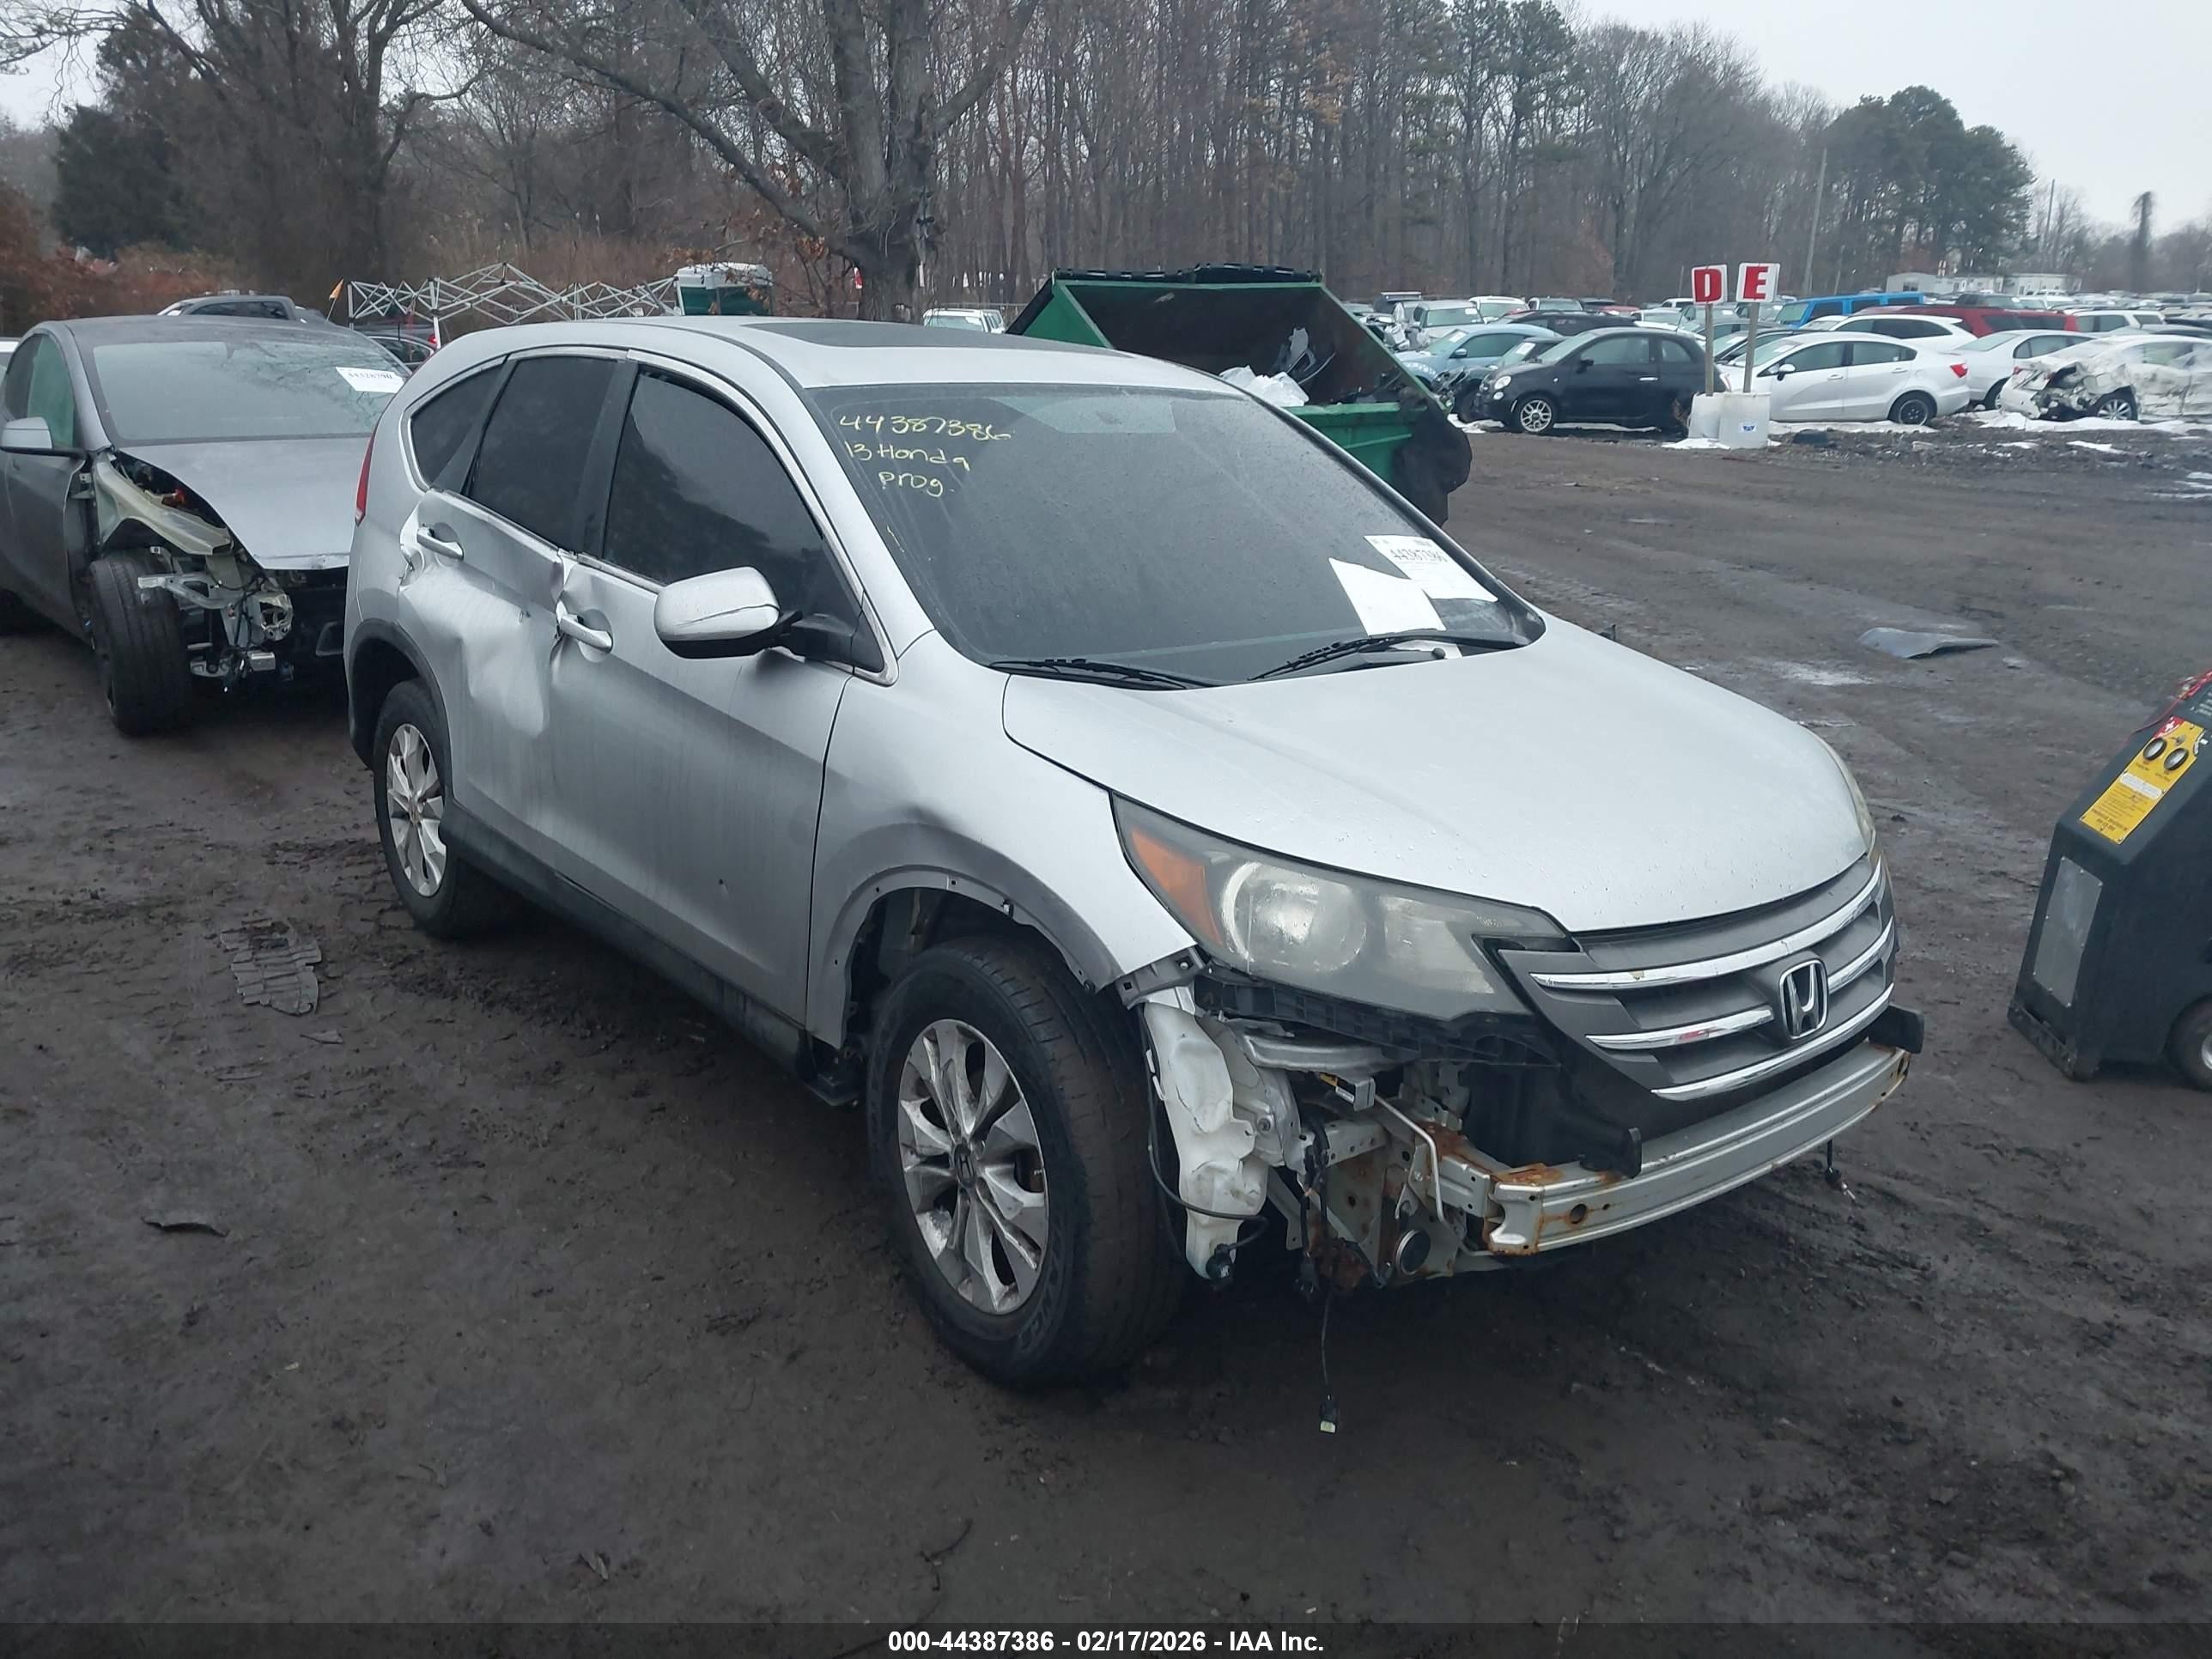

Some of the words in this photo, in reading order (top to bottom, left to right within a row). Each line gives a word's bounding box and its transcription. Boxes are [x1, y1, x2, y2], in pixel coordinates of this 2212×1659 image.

[1693, 268, 1723, 303] D
[1742, 265, 1769, 301] E
[839, 415, 1012, 441] 44387386
